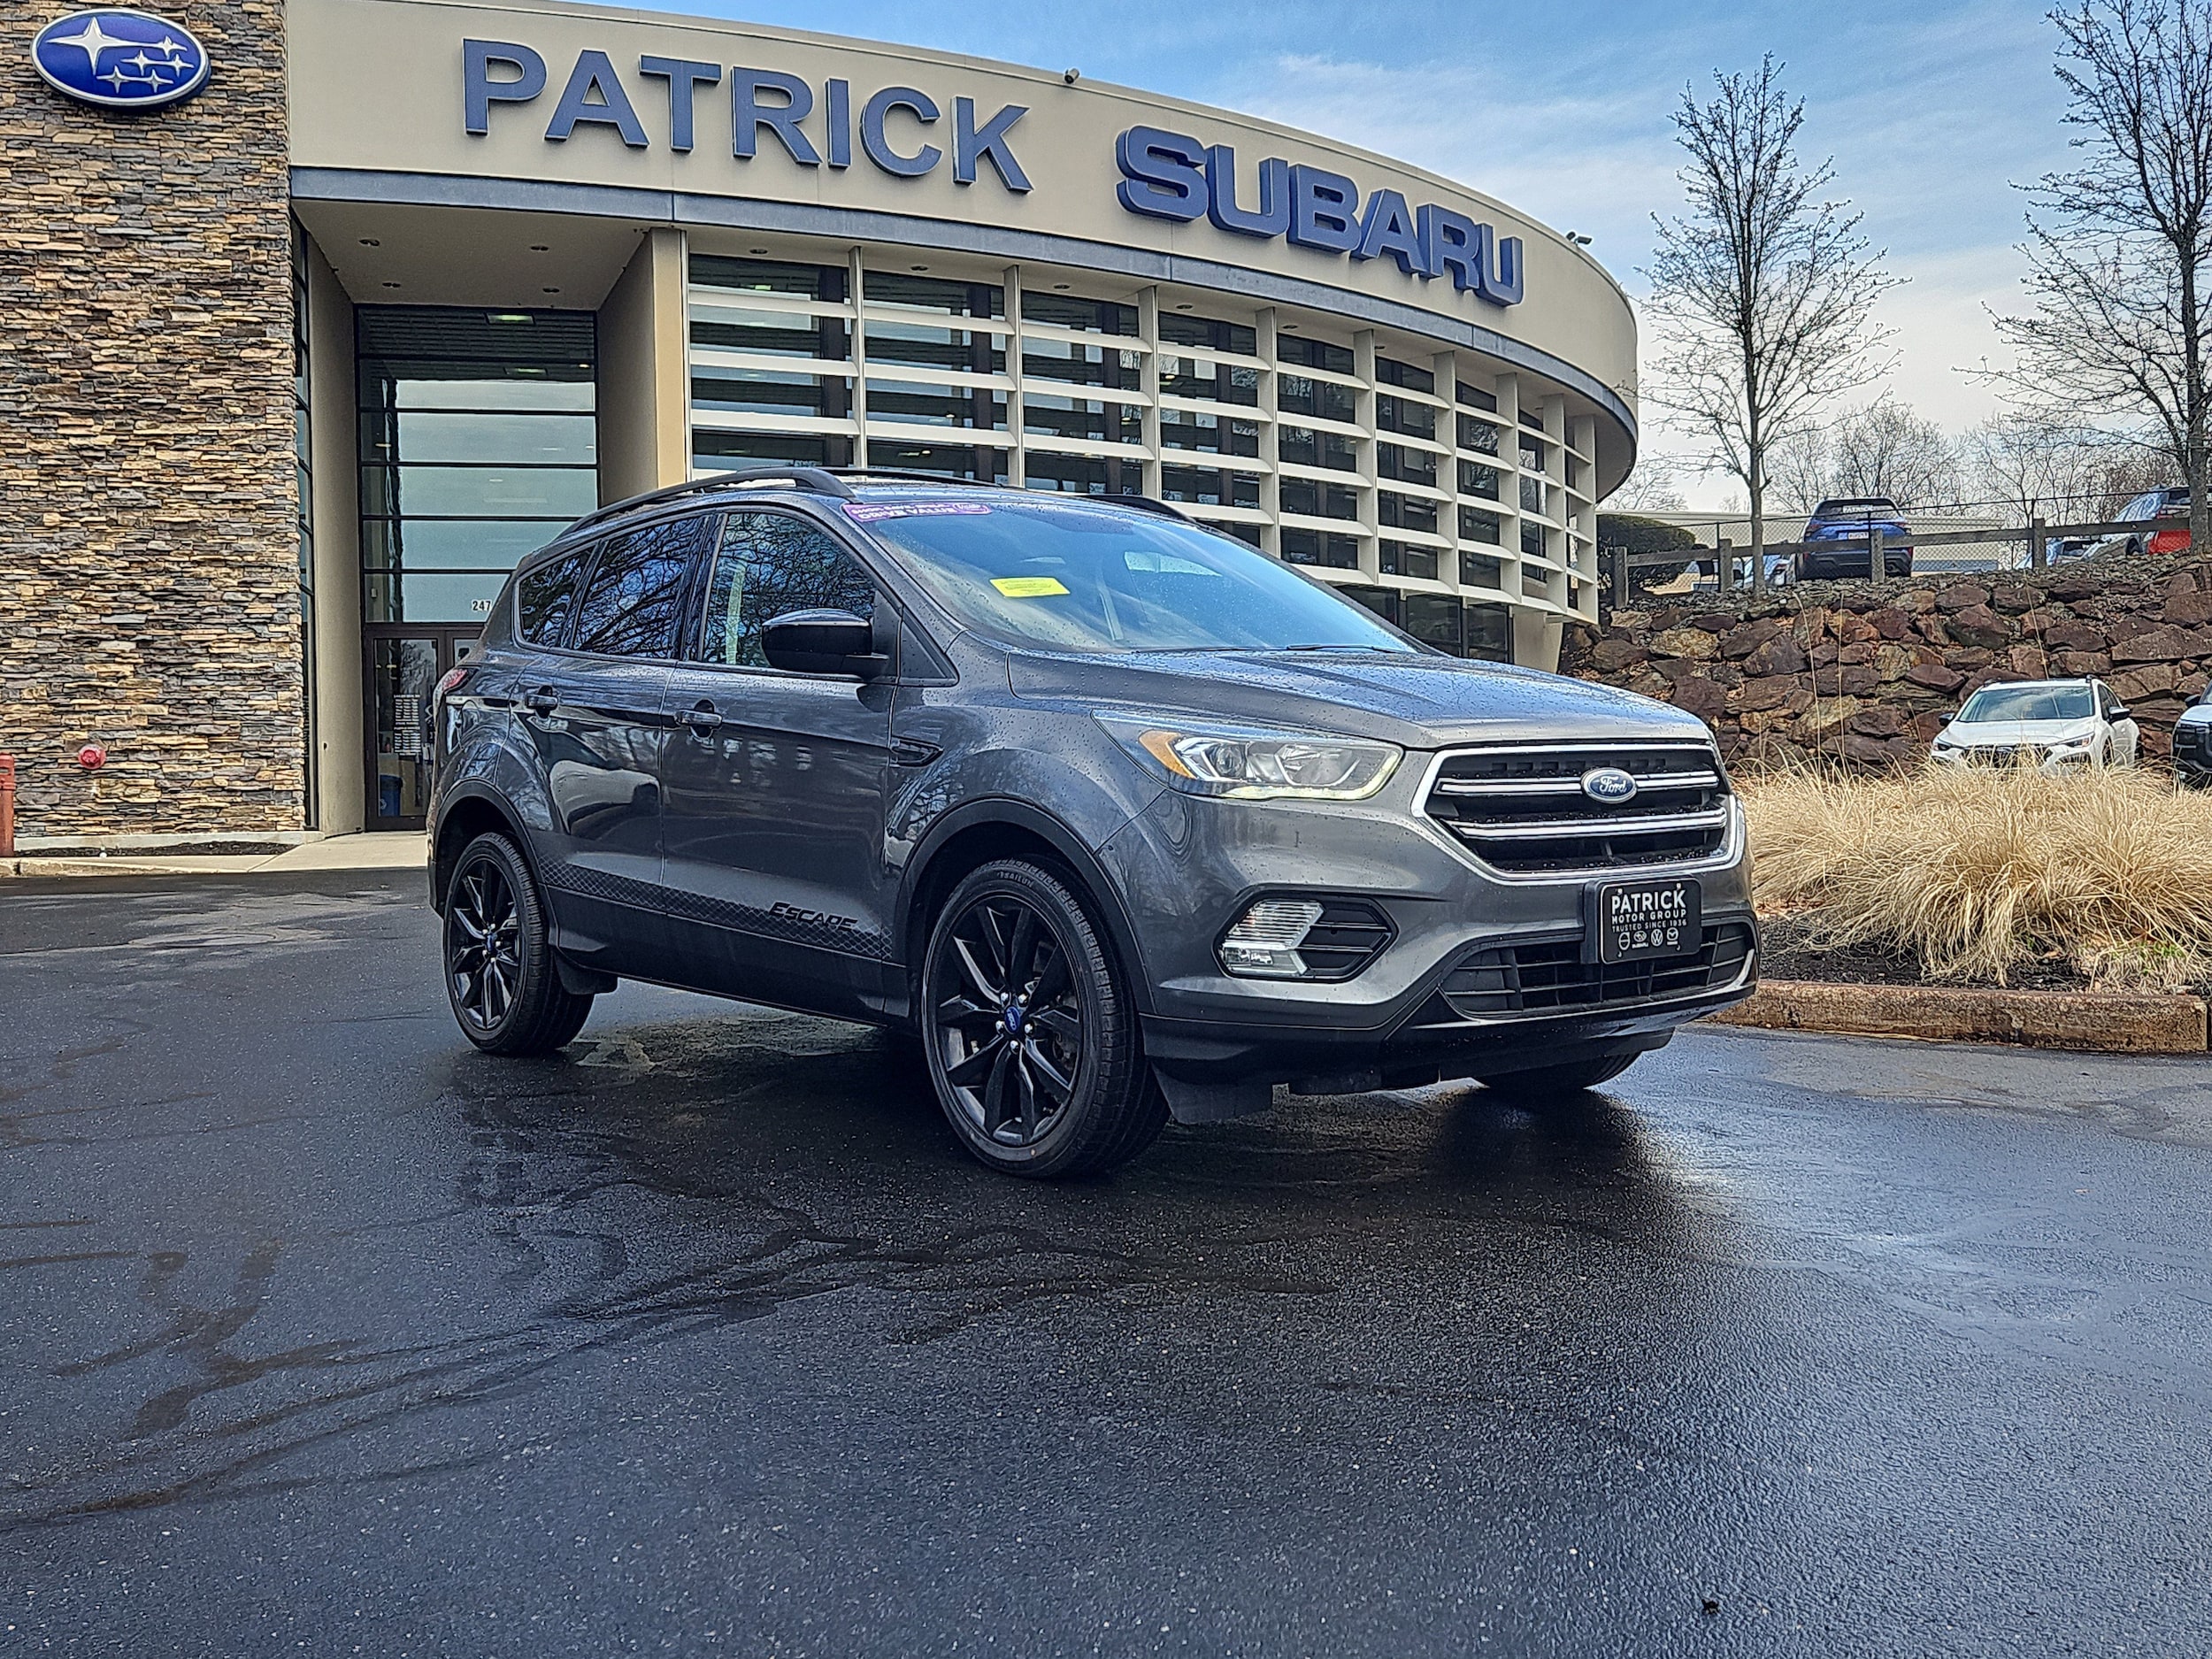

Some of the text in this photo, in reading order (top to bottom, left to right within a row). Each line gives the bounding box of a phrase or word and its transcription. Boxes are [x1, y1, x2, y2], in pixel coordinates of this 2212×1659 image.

[462, 37, 1525, 307] PATRICK SUBARU
[472, 600, 491, 611] 247
[1599, 775, 1627, 794] Ford
[1611, 890, 1686, 914] PATRICK
[768, 901, 858, 932] ESCAPE
[1612, 910, 1686, 924] MOTOR GROUP
[1612, 924, 1642, 933] TRUSTED
[1645, 920, 1666, 929] SINCE
